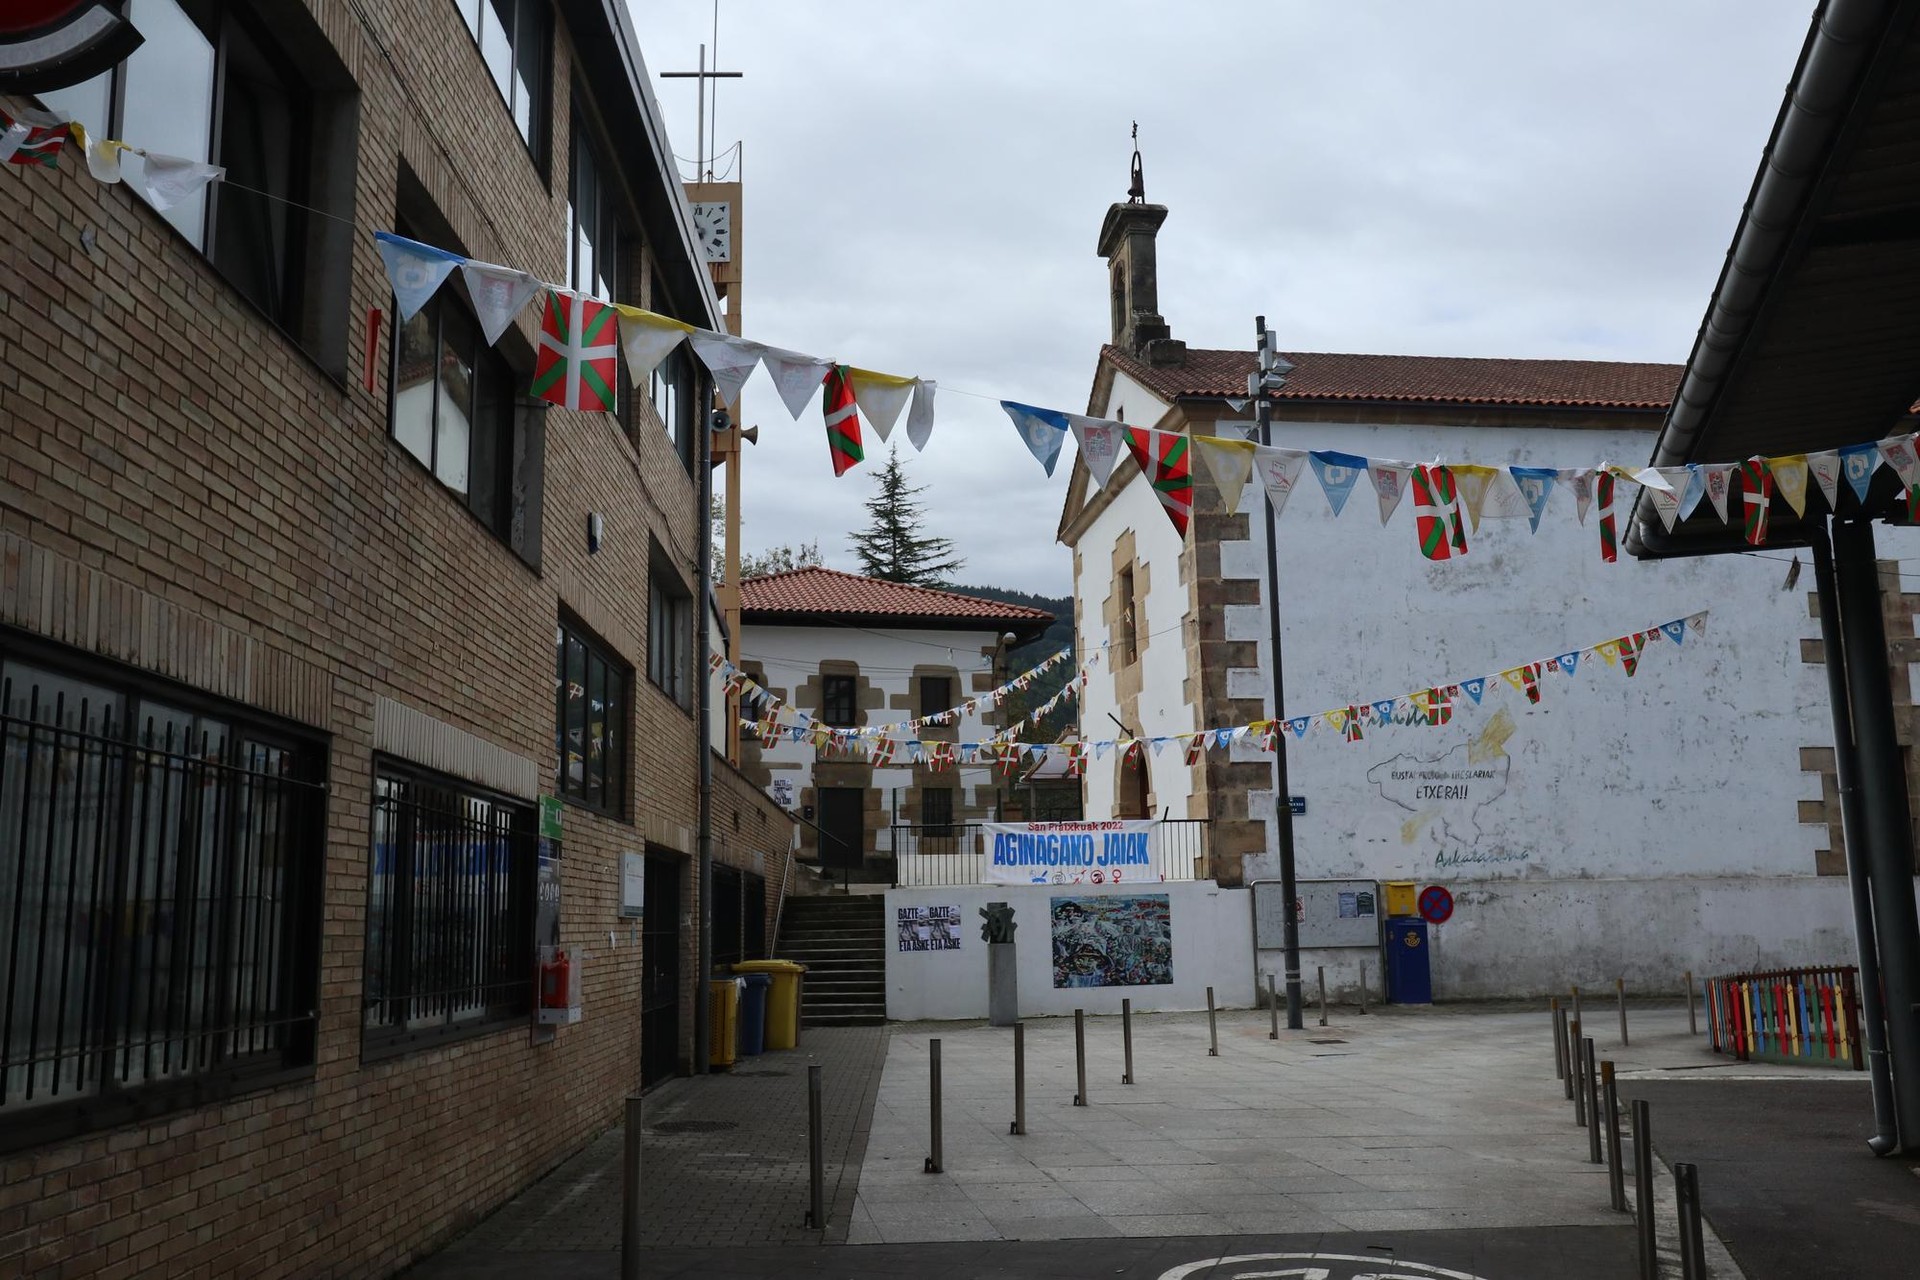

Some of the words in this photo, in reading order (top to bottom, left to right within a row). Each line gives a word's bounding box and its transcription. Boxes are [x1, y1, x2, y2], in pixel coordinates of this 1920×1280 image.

[1416, 785, 1469, 800] ETXERA!!
[1028, 821, 1046, 832] San
[1101, 821, 1123, 831] 2022
[993, 832, 1095, 867] AGINAGAKO
[1097, 832, 1150, 867] JAIAK
[898, 907, 919, 920] GAZTE
[929, 906, 950, 919] GAZTE
[899, 940, 912, 952] ETA
[912, 939, 930, 951] ASKE
[931, 939, 943, 951] ETA
[943, 938, 961, 950] ASKE
